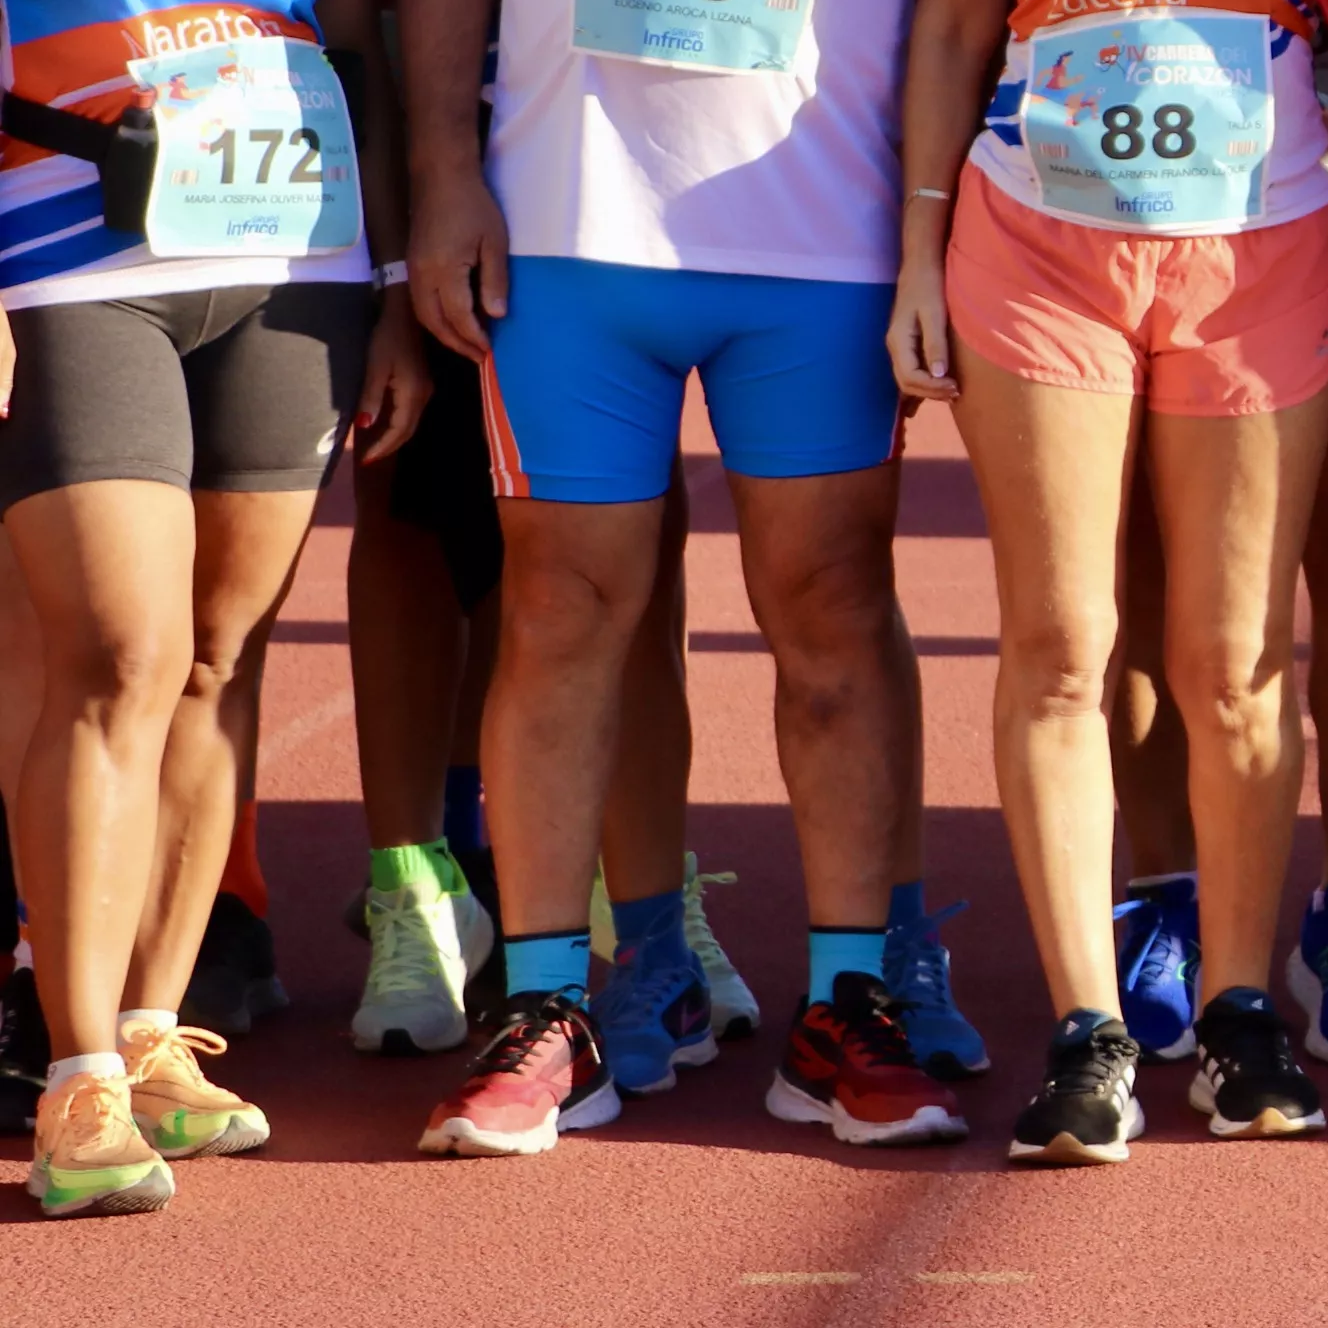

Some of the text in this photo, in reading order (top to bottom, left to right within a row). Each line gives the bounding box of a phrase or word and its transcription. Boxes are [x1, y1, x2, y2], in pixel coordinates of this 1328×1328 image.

[666, 6, 708, 20] AROCA
[710, 13, 752, 26] LIZANA
[643, 28, 704, 53] Infrico
[1126, 44, 1248, 63] IV CARRERA DEL
[1100, 103, 1197, 160] 88
[1228, 121, 1253, 131] TALLA
[208, 127, 324, 185] 172
[1048, 164, 1082, 177] MARIA
[1085, 168, 1104, 180] DEL
[1109, 170, 1158, 181] CARMEN
[184, 194, 216, 205] MARIA
[219, 194, 267, 205] JOSEFINA
[270, 194, 303, 204] OLIVER
[1115, 196, 1174, 213] Infrico
[226, 220, 279, 237] Infrico
